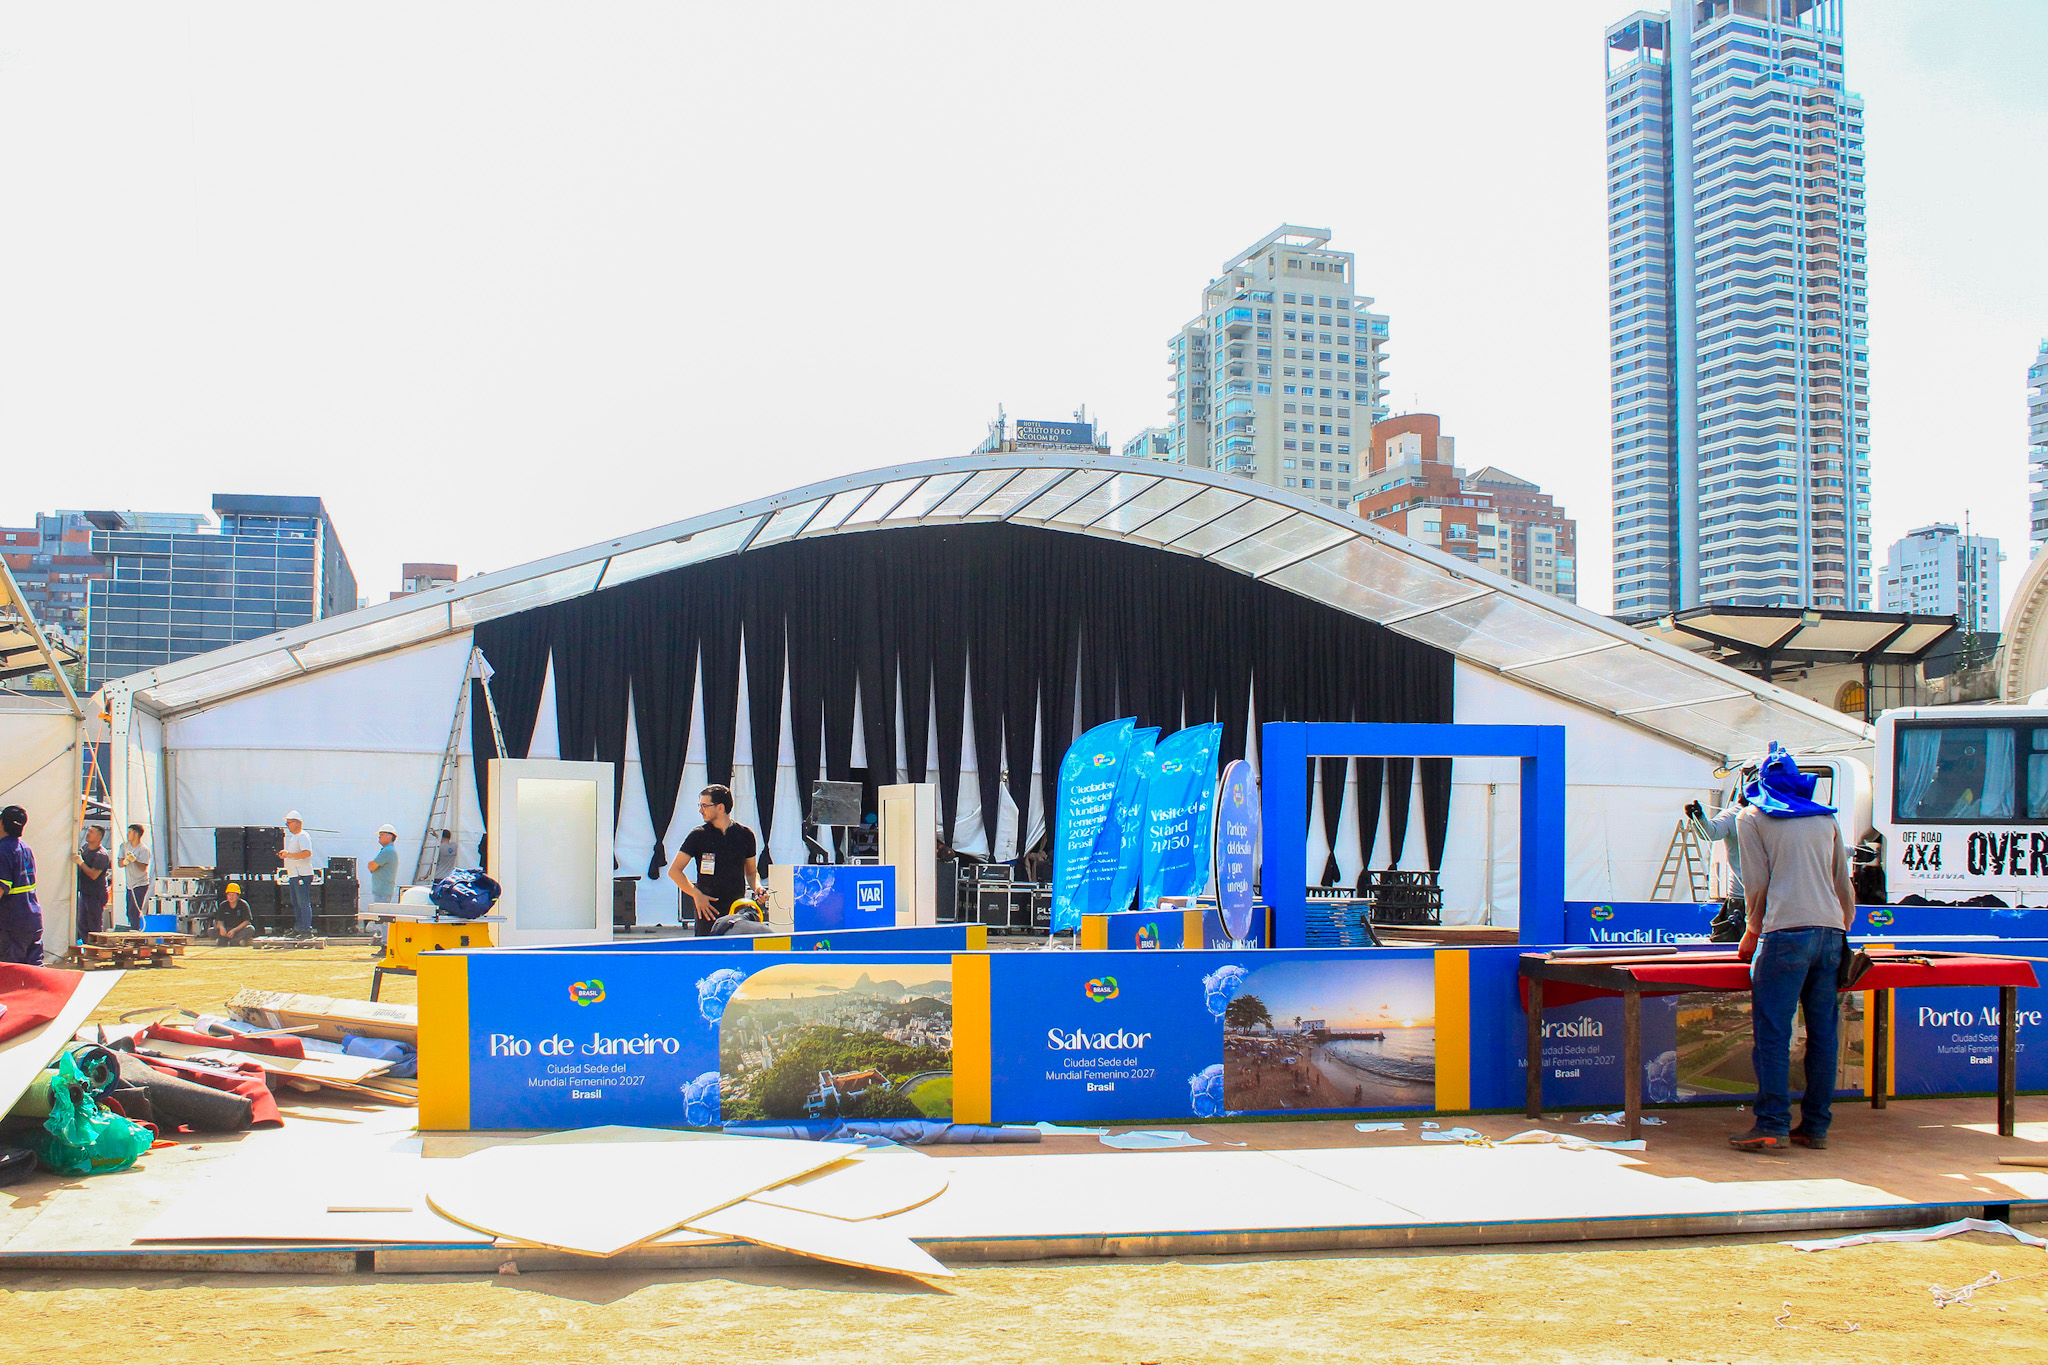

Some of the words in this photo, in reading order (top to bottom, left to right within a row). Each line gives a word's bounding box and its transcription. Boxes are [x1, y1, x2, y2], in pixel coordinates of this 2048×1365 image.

[1023, 427, 1072, 435] CRISTOFORO
[1070, 781, 1115, 795] Ciudades
[1070, 794, 1095, 806] Sede
[1097, 791, 1113, 802] del
[1070, 803, 1105, 817] Mundial
[1150, 807, 1185, 822] Visite
[1069, 814, 1107, 828] Femenin
[1069, 826, 1097, 840] 2027
[1150, 819, 1188, 839] Stand
[1226, 820, 1248, 839] Participe
[1902, 831, 1918, 843] OFF
[1921, 831, 1942, 843] ROAD
[1068, 838, 1093, 850] Brasil
[1227, 841, 1235, 855] del
[860, 887, 880, 902] VAR
[1590, 928, 1653, 943] Mundial
[1141, 940, 1155, 948] BRASIL
[1918, 1006, 1974, 1027] Porto
[1048, 1028, 1152, 1050] Salvador
[1952, 1034, 1978, 1042] Ciudad
[1978, 1033, 1998, 1042] Sede
[490, 1034, 532, 1057] Rio
[538, 1032, 574, 1056] de
[581, 1032, 680, 1056] Janeiro
[1542, 1046, 1563, 1055] udad
[1564, 1045, 1586, 1054] Sede
[1587, 1044, 1600, 1053] del
[1938, 1045, 1966, 1054] Mundial
[1968, 1044, 1999, 1053] Femenin
[1064, 1058, 1096, 1068] Ciudad
[1098, 1057, 1122, 1067] Sede
[1123, 1057, 1138, 1066] del
[1552, 1057, 1592, 1066] Femenino
[1594, 1056, 1616, 1064] 2027
[1970, 1056, 1993, 1064] Brasil
[546, 1064, 582, 1074] Ciudad
[584, 1064, 609, 1074] Sede
[611, 1063, 626, 1073] del
[1046, 1070, 1082, 1080] Mundial
[1084, 1070, 1129, 1080] Femenino
[1131, 1068, 1155, 1078] 2027
[1554, 1068, 1580, 1078] Brasil
[528, 1077, 567, 1086] Mundial
[569, 1076, 618, 1086] Femenino
[620, 1076, 645, 1086] 2027
[1087, 1082, 1114, 1092] Brasil
[572, 1090, 602, 1099] Brasil
